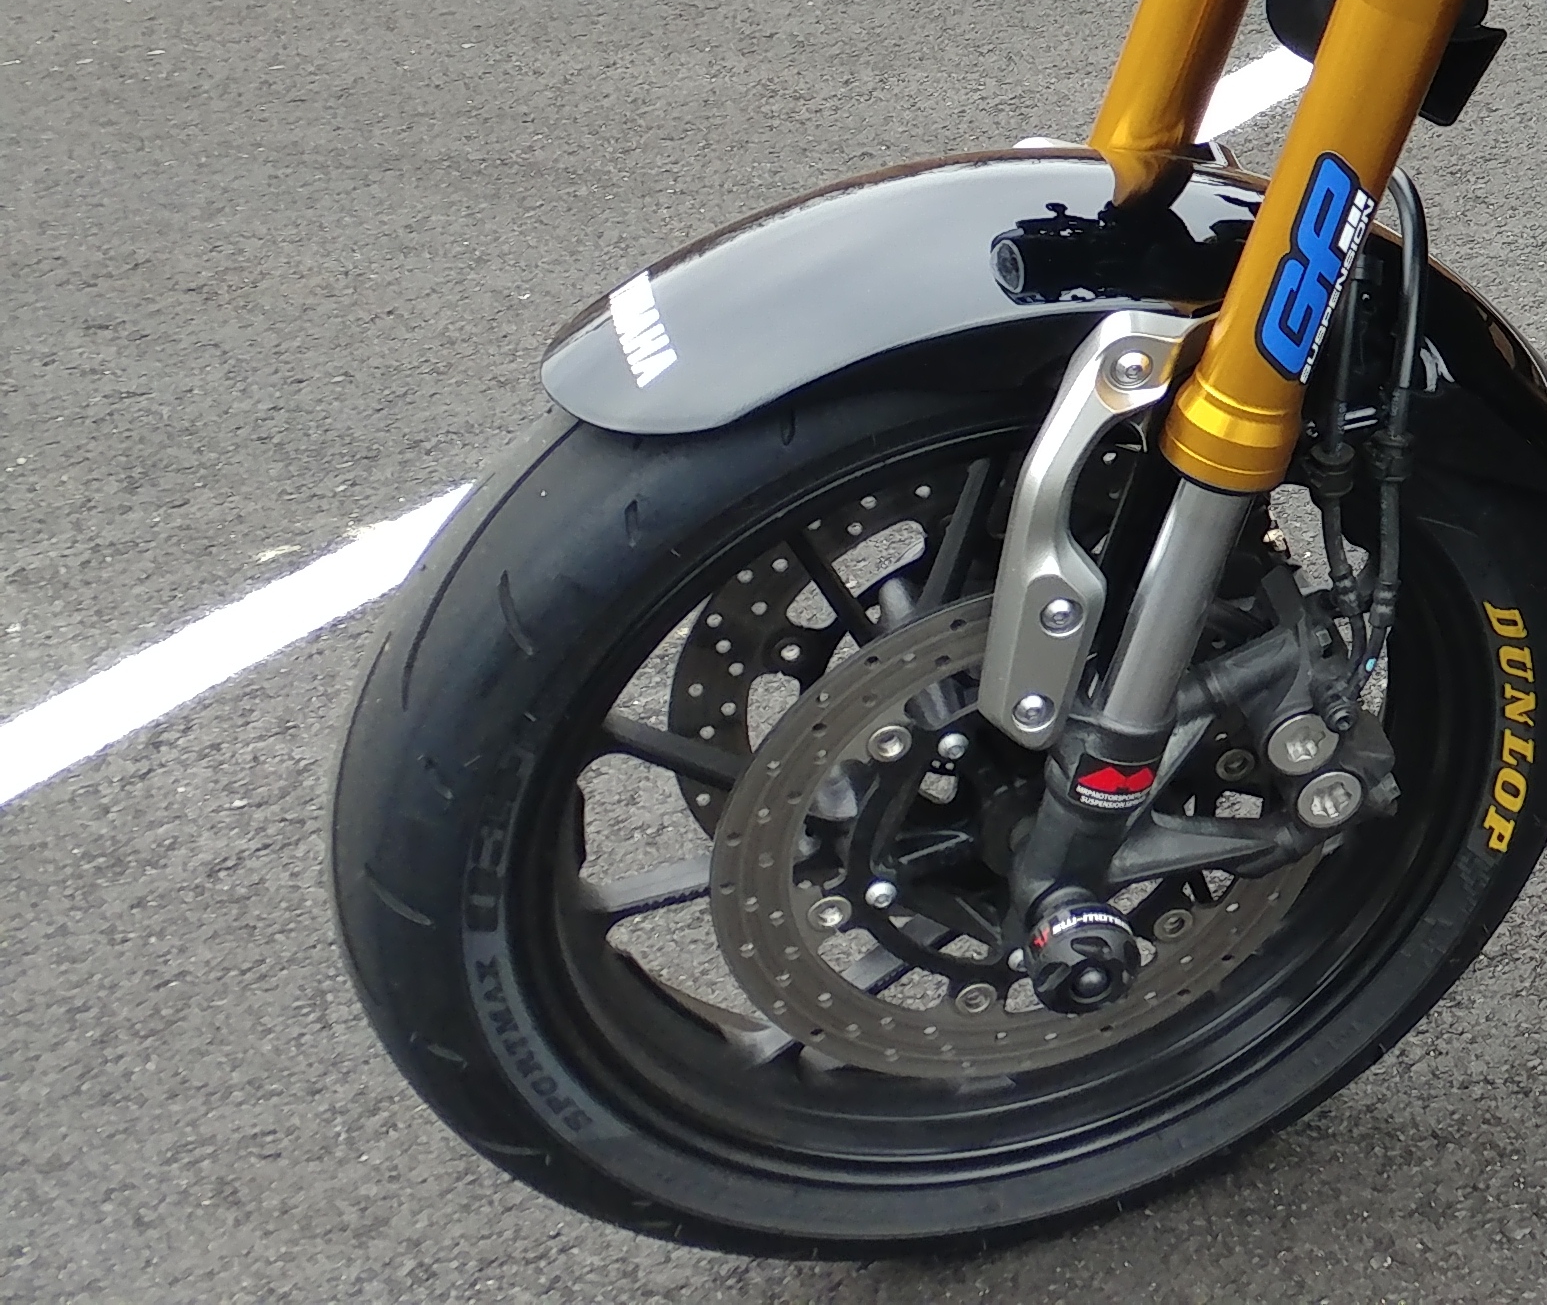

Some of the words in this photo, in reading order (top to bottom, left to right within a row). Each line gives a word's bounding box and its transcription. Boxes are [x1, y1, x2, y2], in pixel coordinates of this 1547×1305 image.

[608, 270, 678, 389] YAMA
[1261, 158, 1352, 375] GP
[1300, 196, 1376, 385] SUSPENSION
[1483, 599, 1537, 853] DUNLOP
[475, 954, 594, 1133] SPORTMAX
